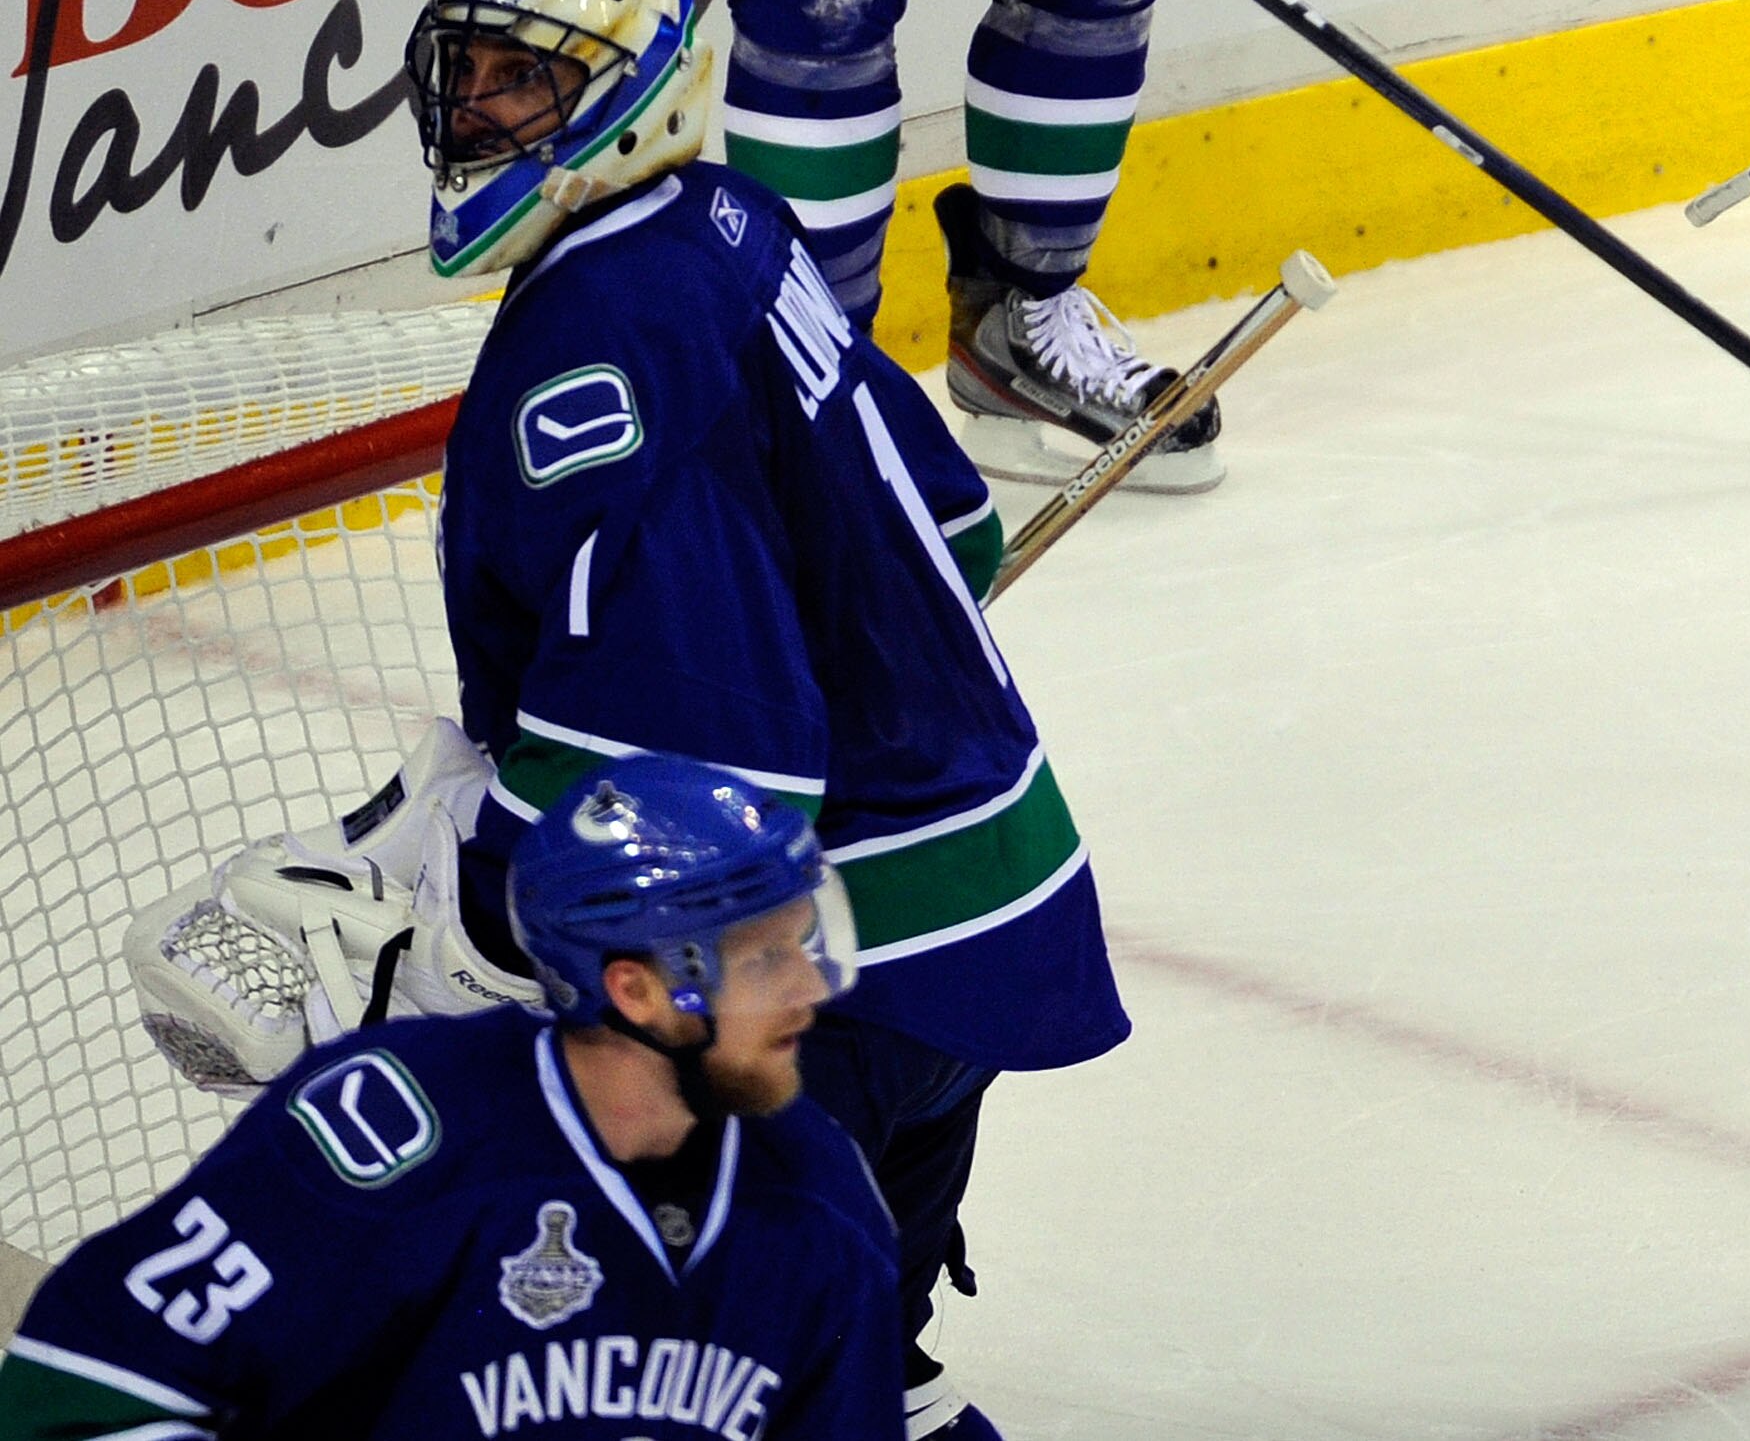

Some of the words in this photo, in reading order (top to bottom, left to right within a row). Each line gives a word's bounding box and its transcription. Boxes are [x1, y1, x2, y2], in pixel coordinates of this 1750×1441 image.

[1062, 410, 1158, 507] Reebok
[125, 1197, 273, 1344] 23
[459, 1335, 783, 1441] VANCOUVE
